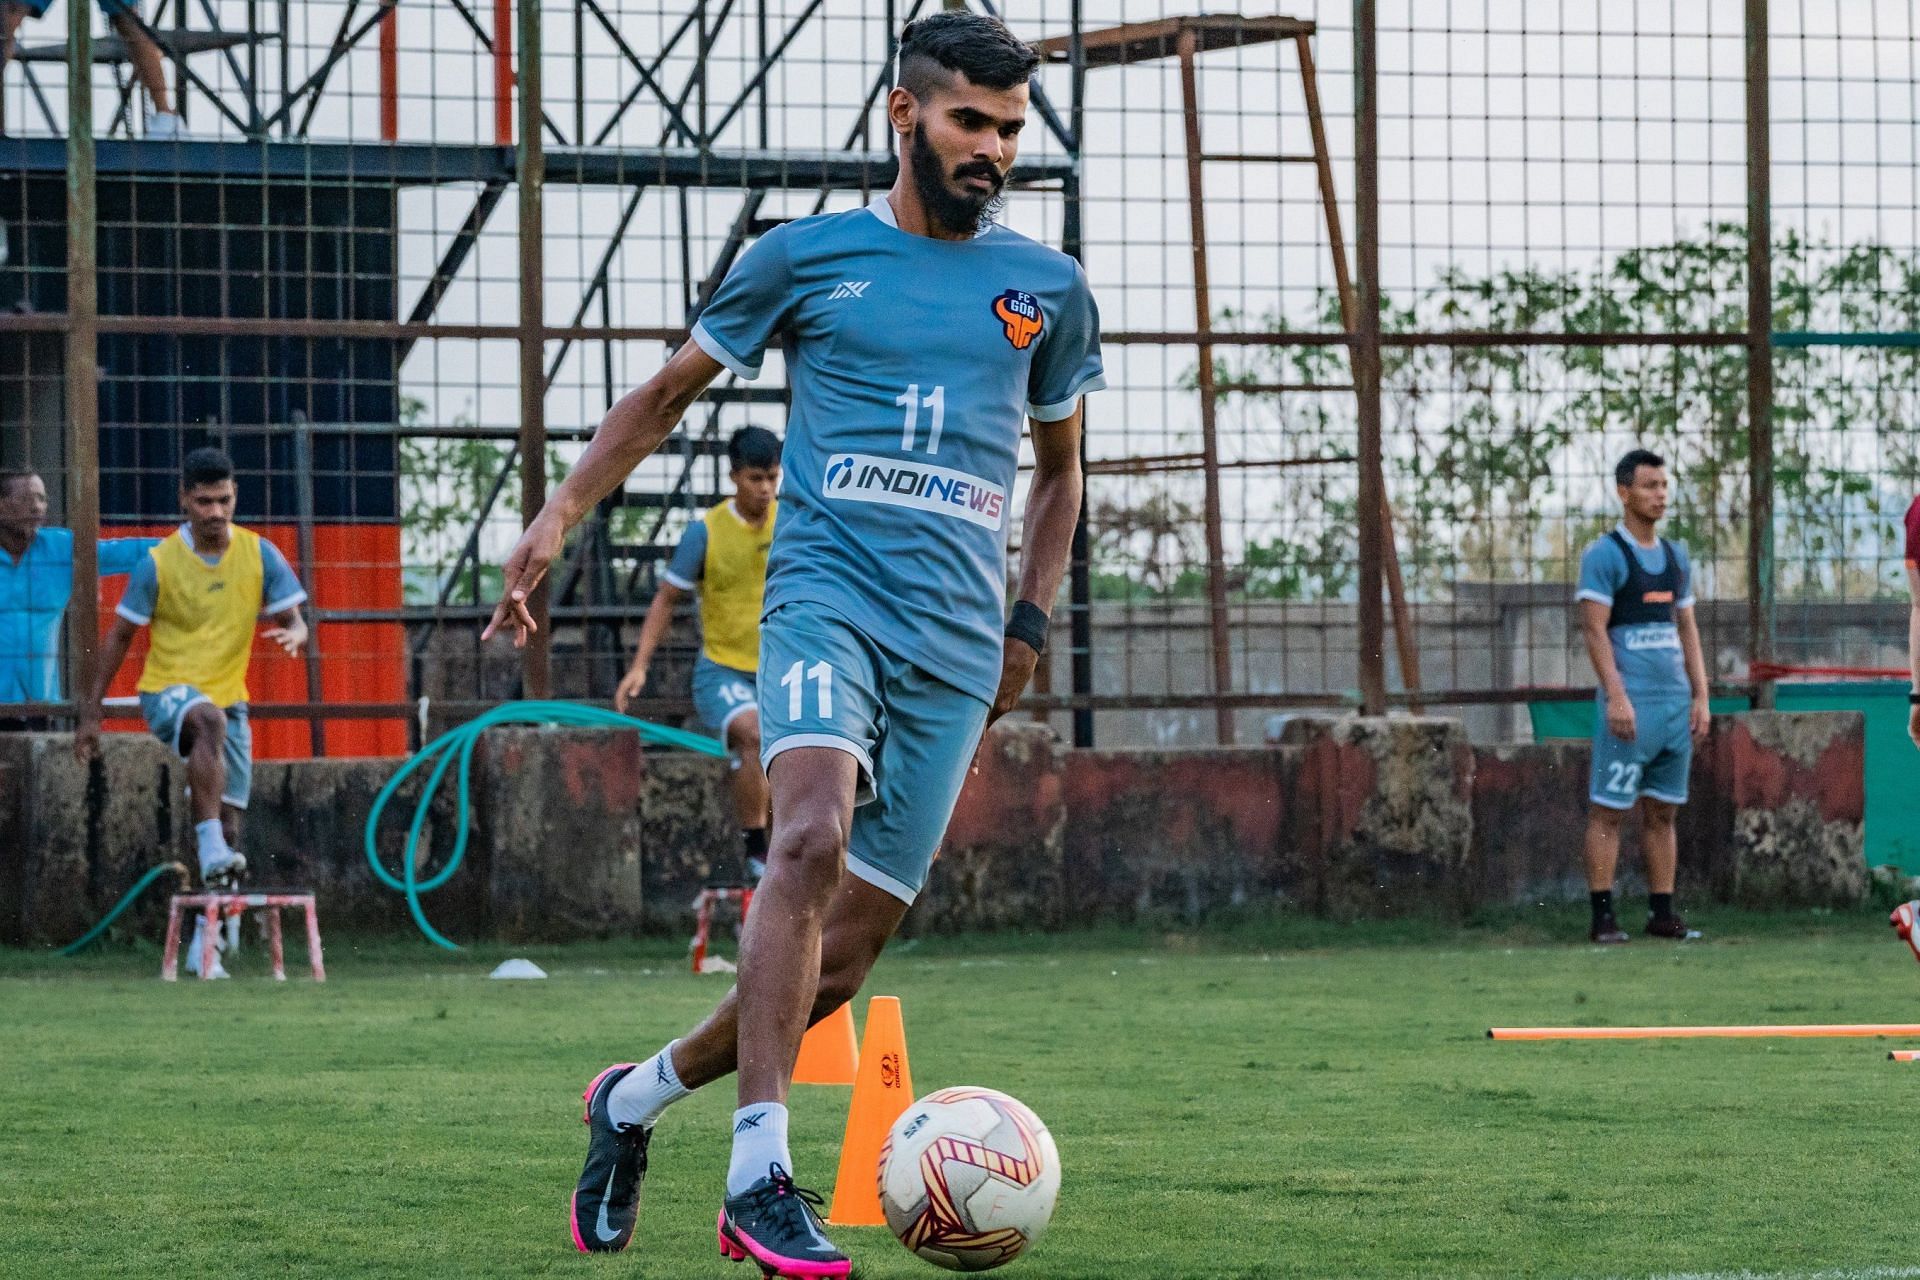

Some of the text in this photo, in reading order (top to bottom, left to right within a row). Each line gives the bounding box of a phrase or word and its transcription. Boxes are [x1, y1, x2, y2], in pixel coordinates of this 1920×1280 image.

[1010, 300, 1035, 318] GOA
[1018, 292, 1030, 303] FC
[896, 383, 945, 455] 11
[856, 464, 1004, 519] INDINEWS
[780, 660, 833, 722] 11
[1606, 761, 1639, 794] 22
